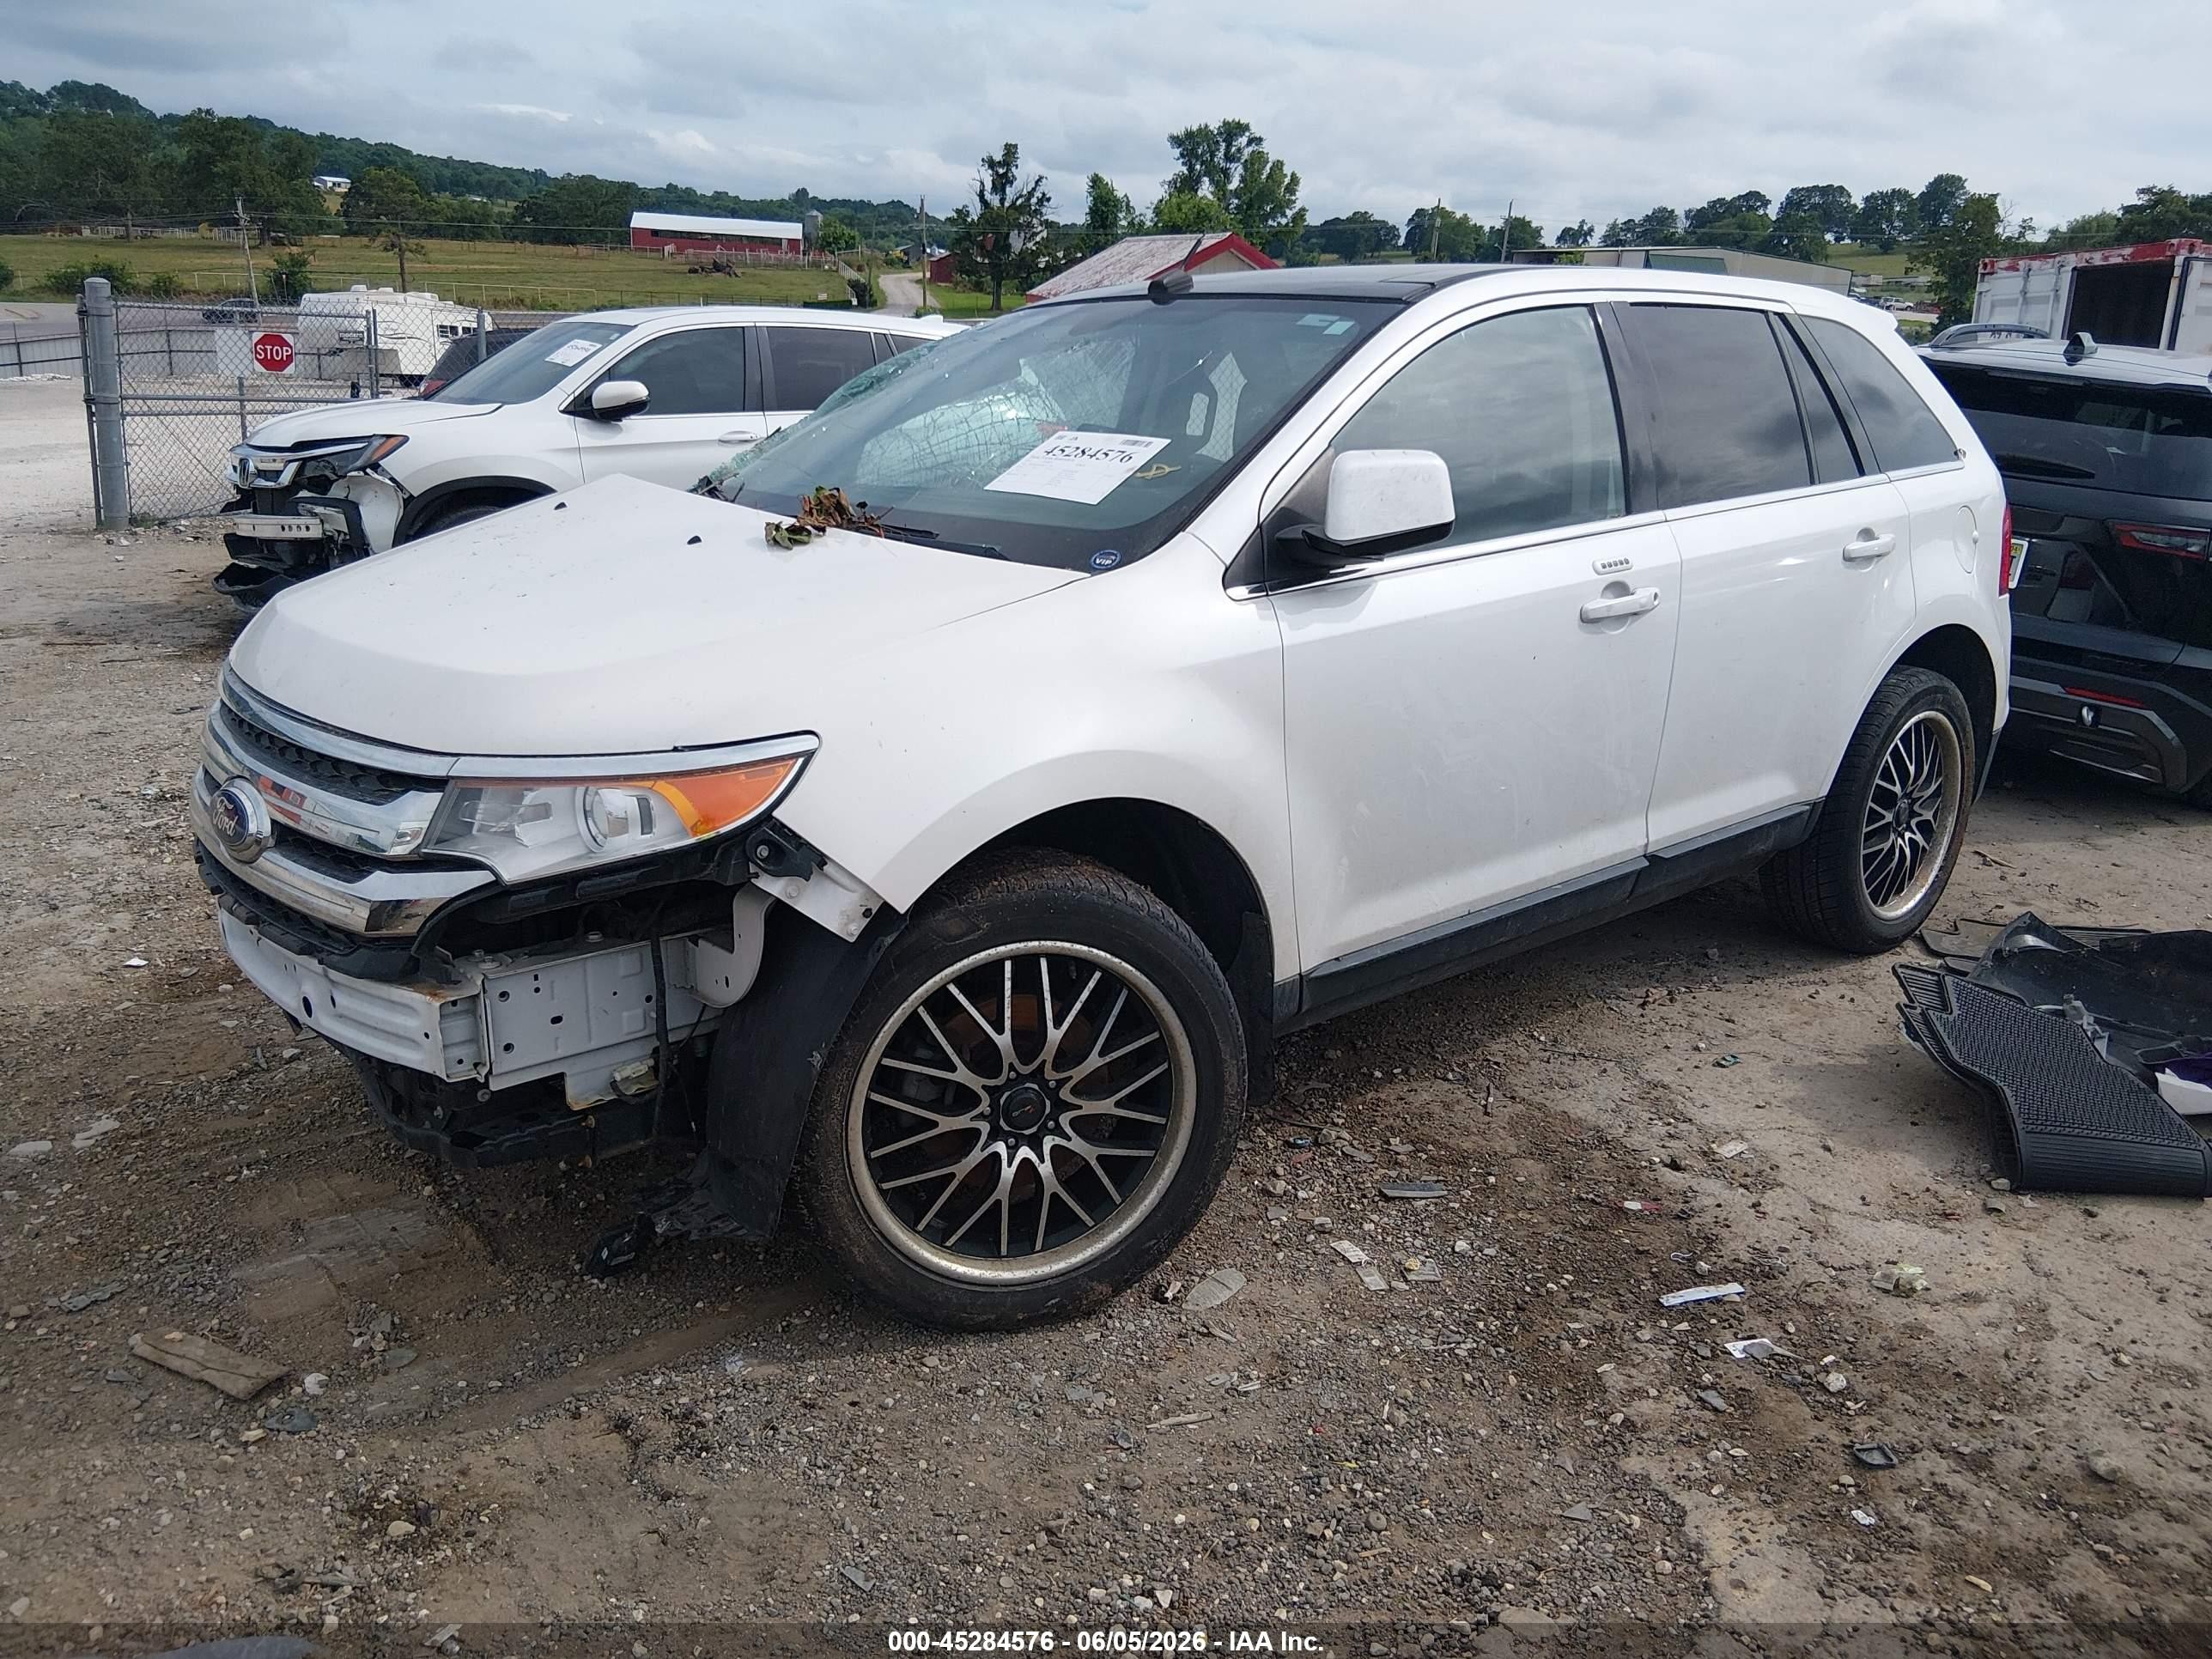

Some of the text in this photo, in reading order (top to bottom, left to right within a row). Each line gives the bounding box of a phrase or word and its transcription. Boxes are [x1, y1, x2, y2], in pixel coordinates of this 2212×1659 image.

[256, 344, 292, 361] STOP
[1043, 445, 1136, 464] 45284576
[212, 796, 239, 836] Ford
